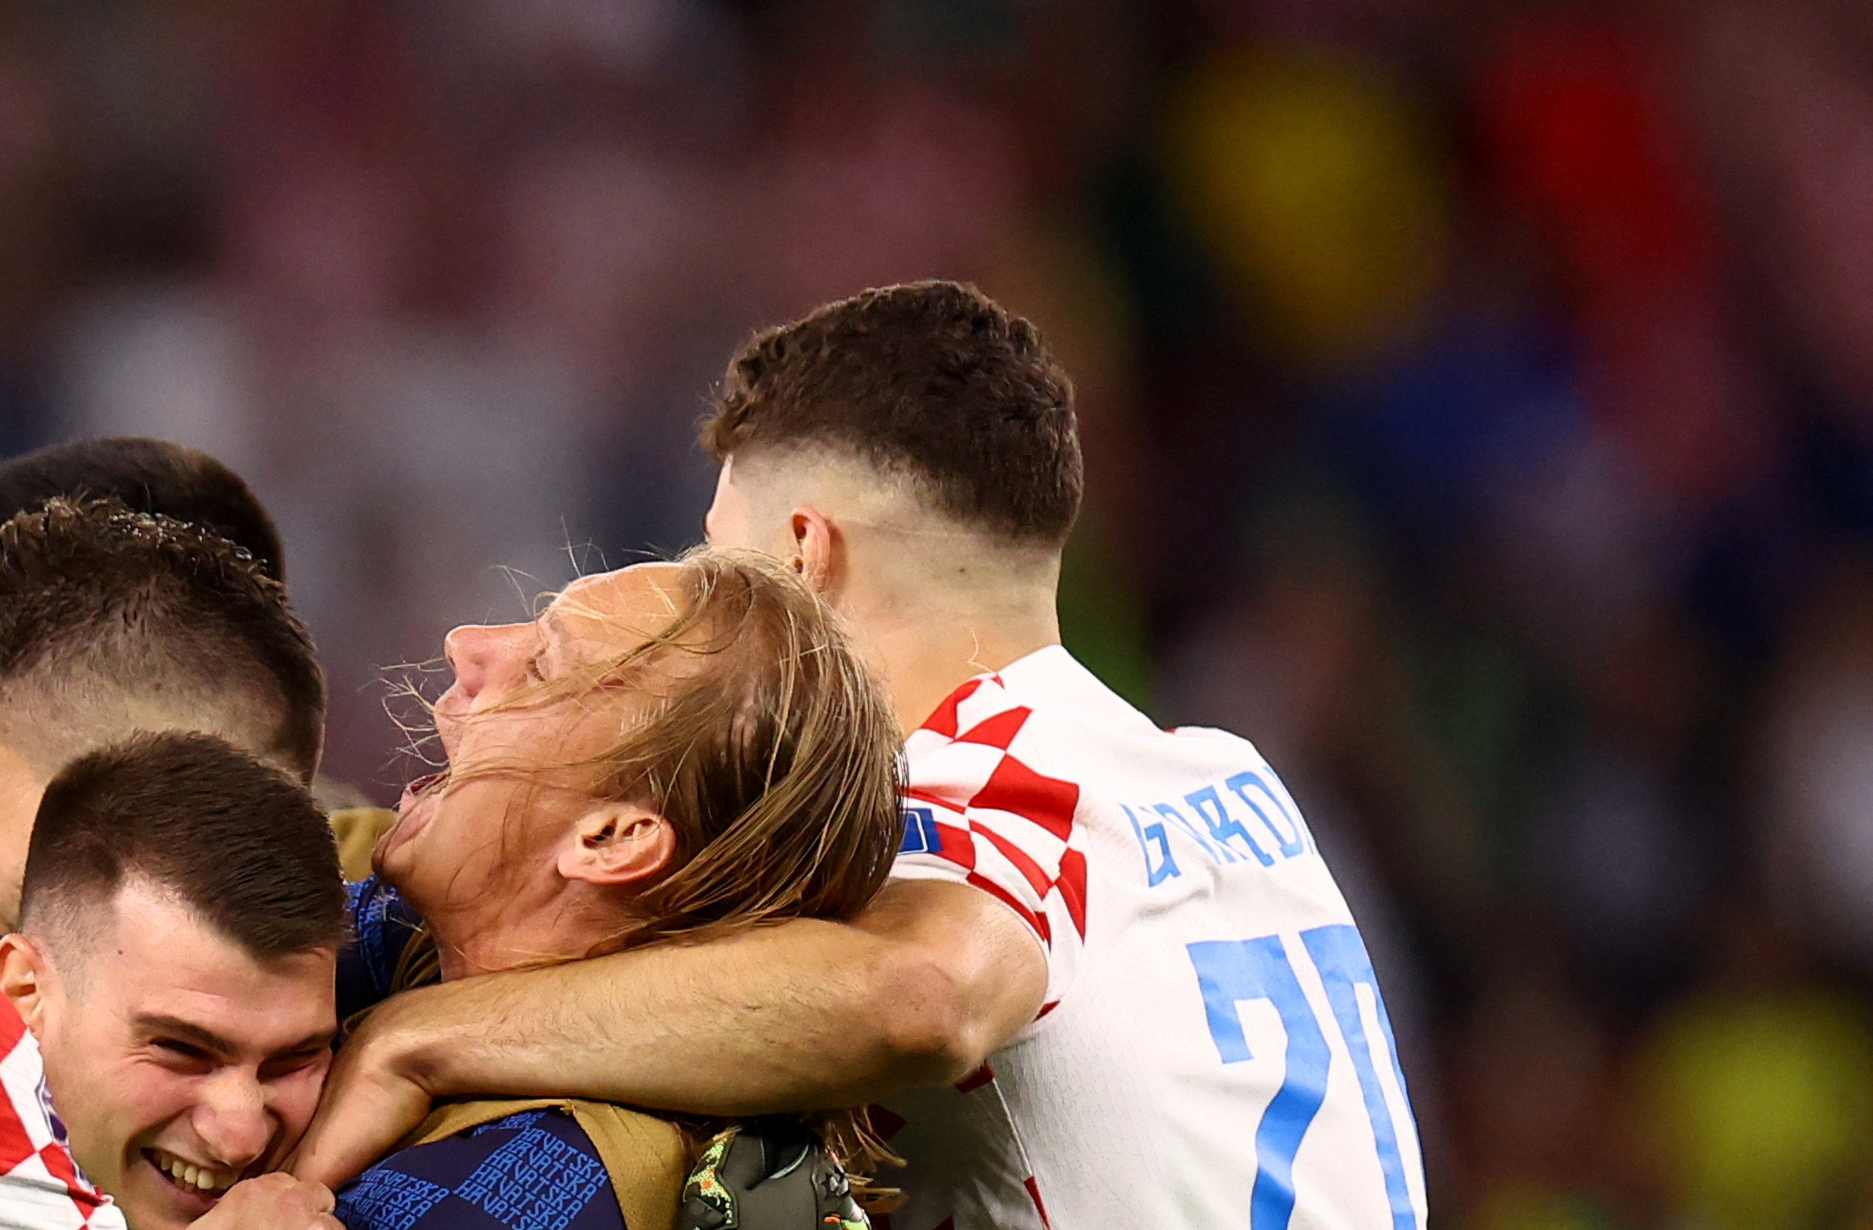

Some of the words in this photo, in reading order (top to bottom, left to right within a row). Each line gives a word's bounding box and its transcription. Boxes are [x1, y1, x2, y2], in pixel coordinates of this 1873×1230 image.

[484, 1150, 584, 1219] HRVATSKA
[501, 1138, 597, 1203] HRVATSKA
[516, 1128, 608, 1187] HRVATSKA
